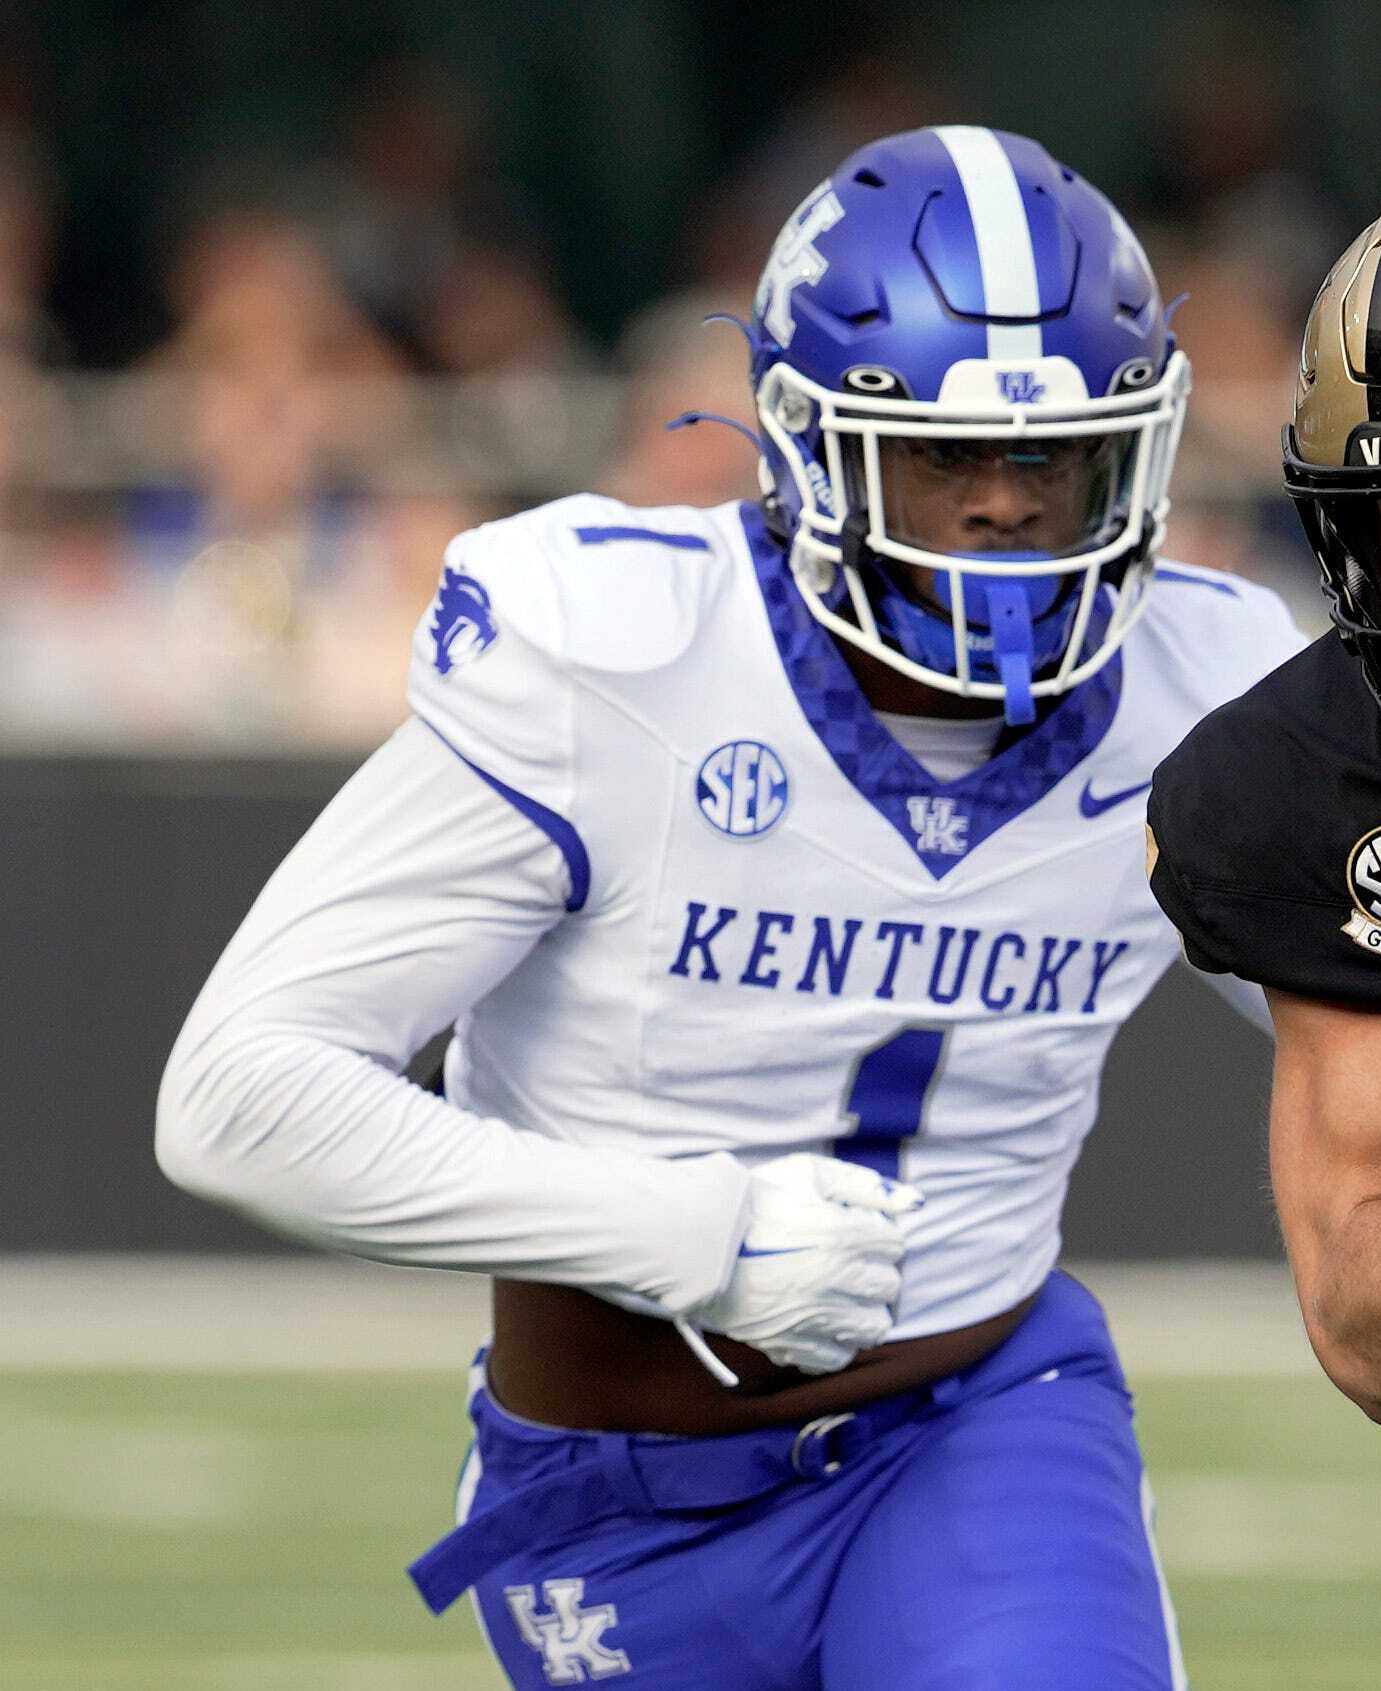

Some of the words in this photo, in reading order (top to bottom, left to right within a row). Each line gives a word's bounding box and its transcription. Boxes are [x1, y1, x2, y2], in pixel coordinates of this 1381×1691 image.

[699, 744, 788, 835] SEC
[906, 796, 969, 855] UK
[669, 902, 1130, 1013] KENTUCKY
[830, 1023, 954, 1182] 1
[502, 1577, 633, 1687] UK
